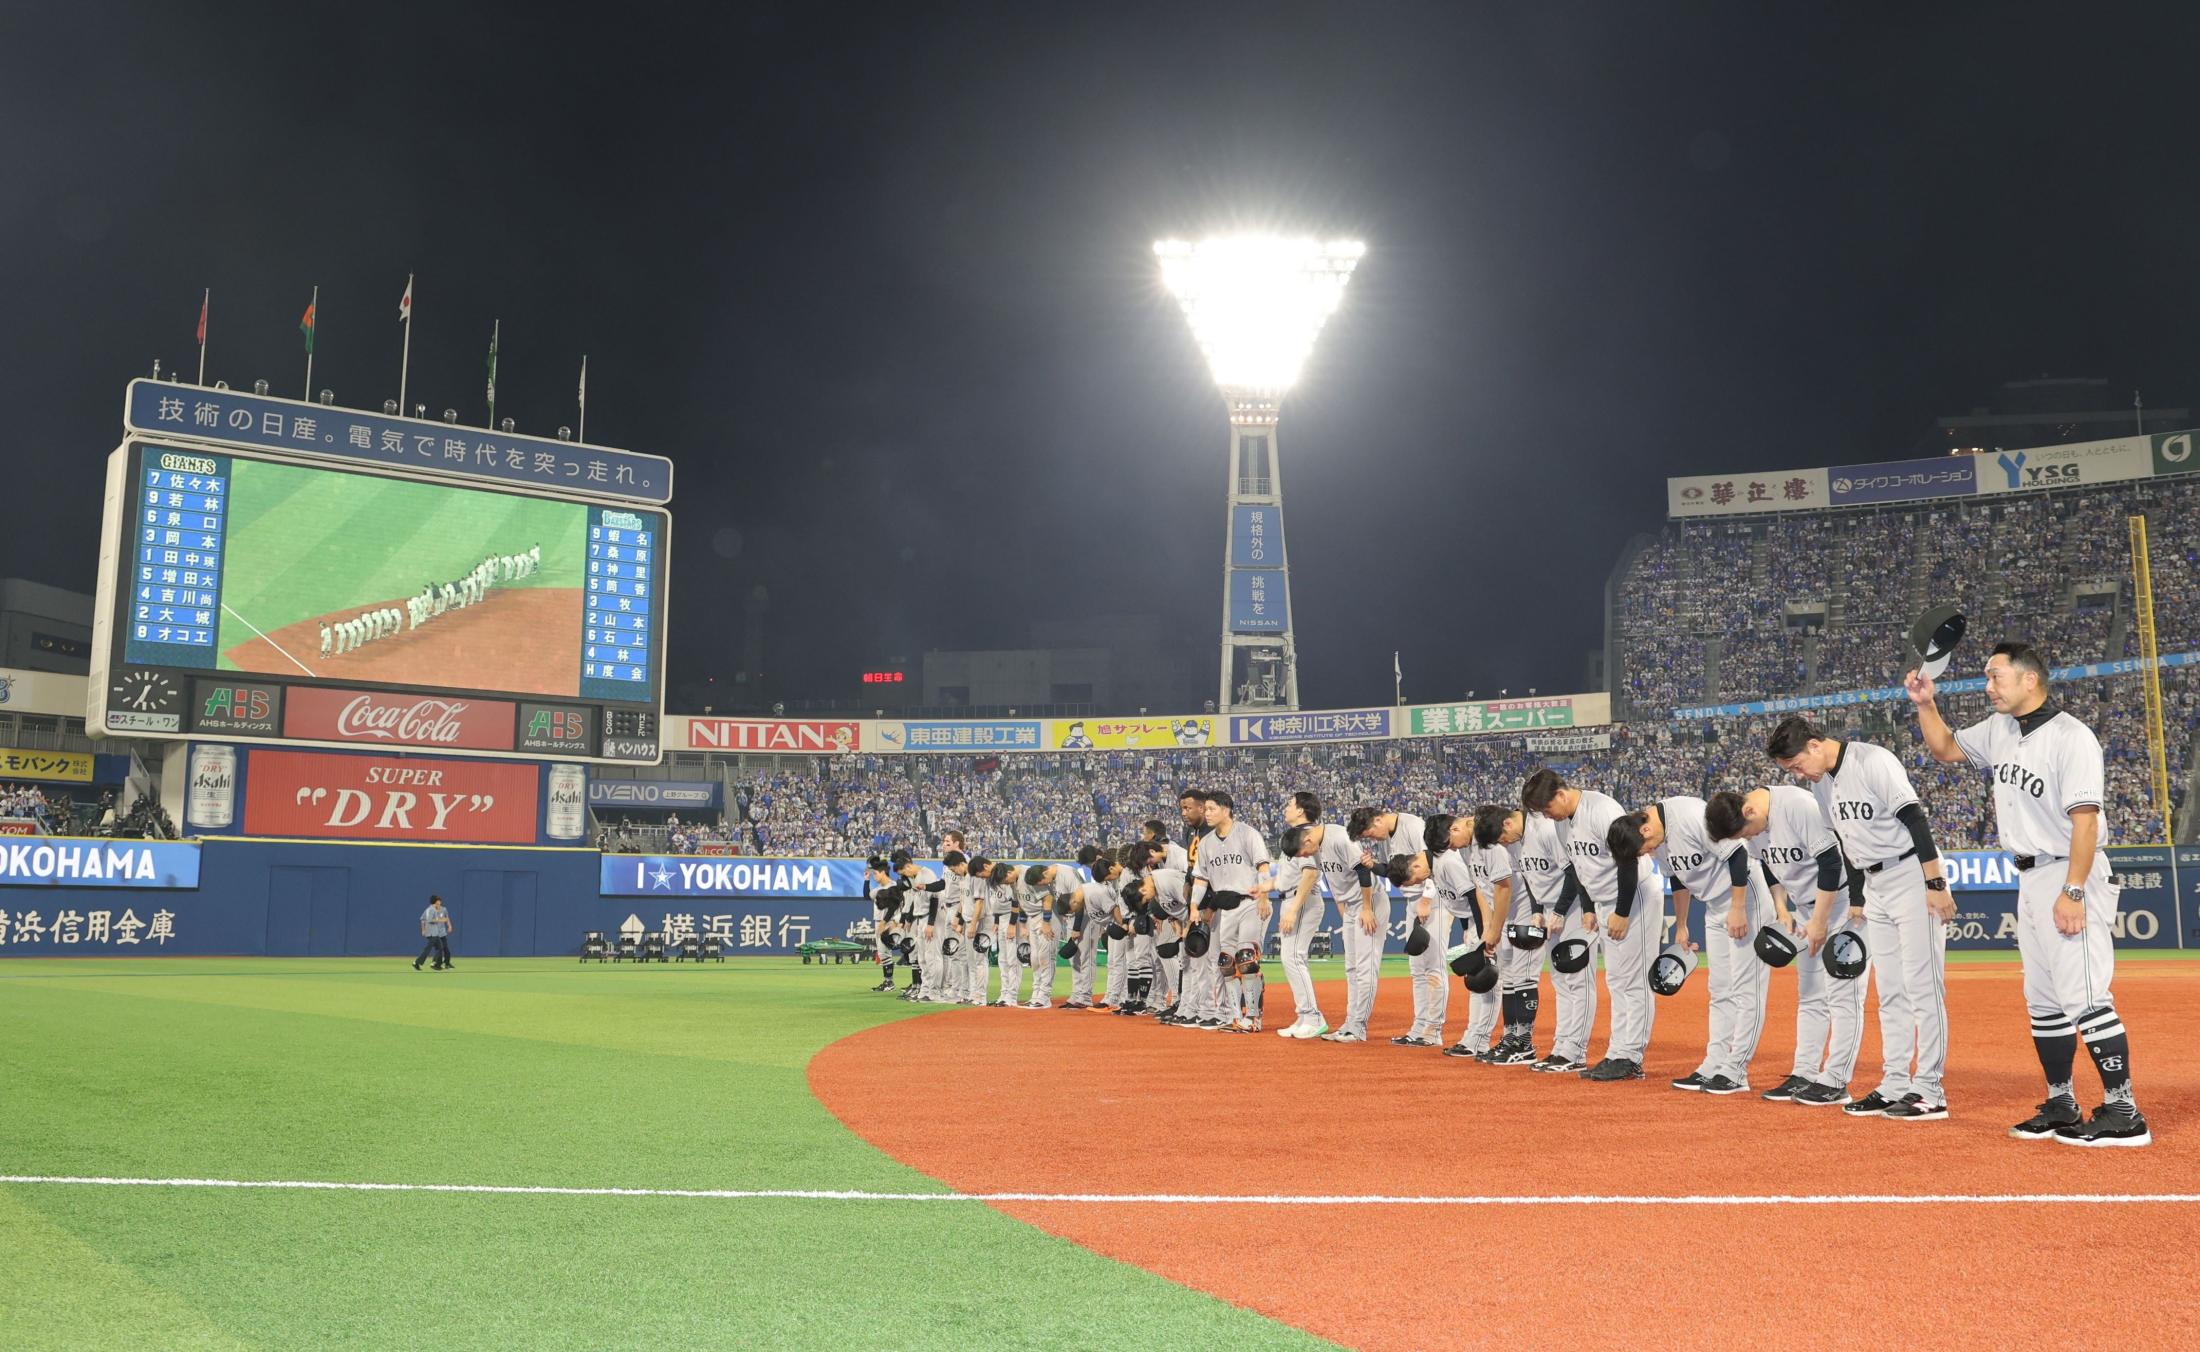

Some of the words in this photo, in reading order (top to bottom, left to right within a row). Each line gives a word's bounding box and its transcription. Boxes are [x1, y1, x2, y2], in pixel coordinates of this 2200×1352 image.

[161, 454, 216, 474] GIANTS
[2026, 463, 2080, 480] YSG
[150, 472, 160, 484] 7
[170, 474, 220, 492] 佐々木
[2022, 476, 2081, 487] HOLDINGS
[149, 491, 159, 503] 9
[168, 493, 219, 512] 若林
[147, 510, 157, 522] 6
[167, 512, 217, 529] 泉口
[145, 529, 155, 541] 3
[165, 531, 216, 549] 岡本
[592, 528, 601, 539] 9
[1250, 511, 1264, 560] 規格外の
[145, 548, 152, 560] 1
[592, 544, 600, 555] 7
[142, 567, 153, 580] 5
[162, 569, 214, 587] 増田大
[591, 562, 599, 573] 8
[590, 579, 598, 589] 5
[141, 587, 151, 599] 4
[161, 588, 213, 606] 吉川尚
[590, 595, 598, 607] 3
[1251, 576, 1265, 615] 挑戦を
[138, 606, 149, 619] 2
[159, 607, 210, 625] 大城
[588, 612, 597, 624] 2
[604, 613, 645, 629] 山本
[137, 625, 147, 638] 8
[158, 627, 208, 643] オコエ
[588, 629, 596, 641] 6
[603, 631, 644, 646] 石上
[587, 646, 595, 658] 4
[617, 648, 629, 661] 林
[586, 663, 595, 675] H
[602, 664, 642, 680] 度会
[199, 719, 272, 731] AHSホールディングス
[1269, 712, 1383, 735] 神奈川工科大学
[1421, 705, 1565, 734] 業務スーパー
[692, 722, 824, 749] NITTAN
[909, 726, 1037, 746] 東亜建設工業
[0, 755, 70, 774] モバンク
[193, 772, 231, 789] Asahi
[365, 767, 444, 786] SUPER
[551, 789, 582, 804] Asahi
[1209, 853, 1243, 868] TOKYO
[679, 862, 833, 891] YOKOHAMA
[662, 912, 811, 949] 横浜銀行
